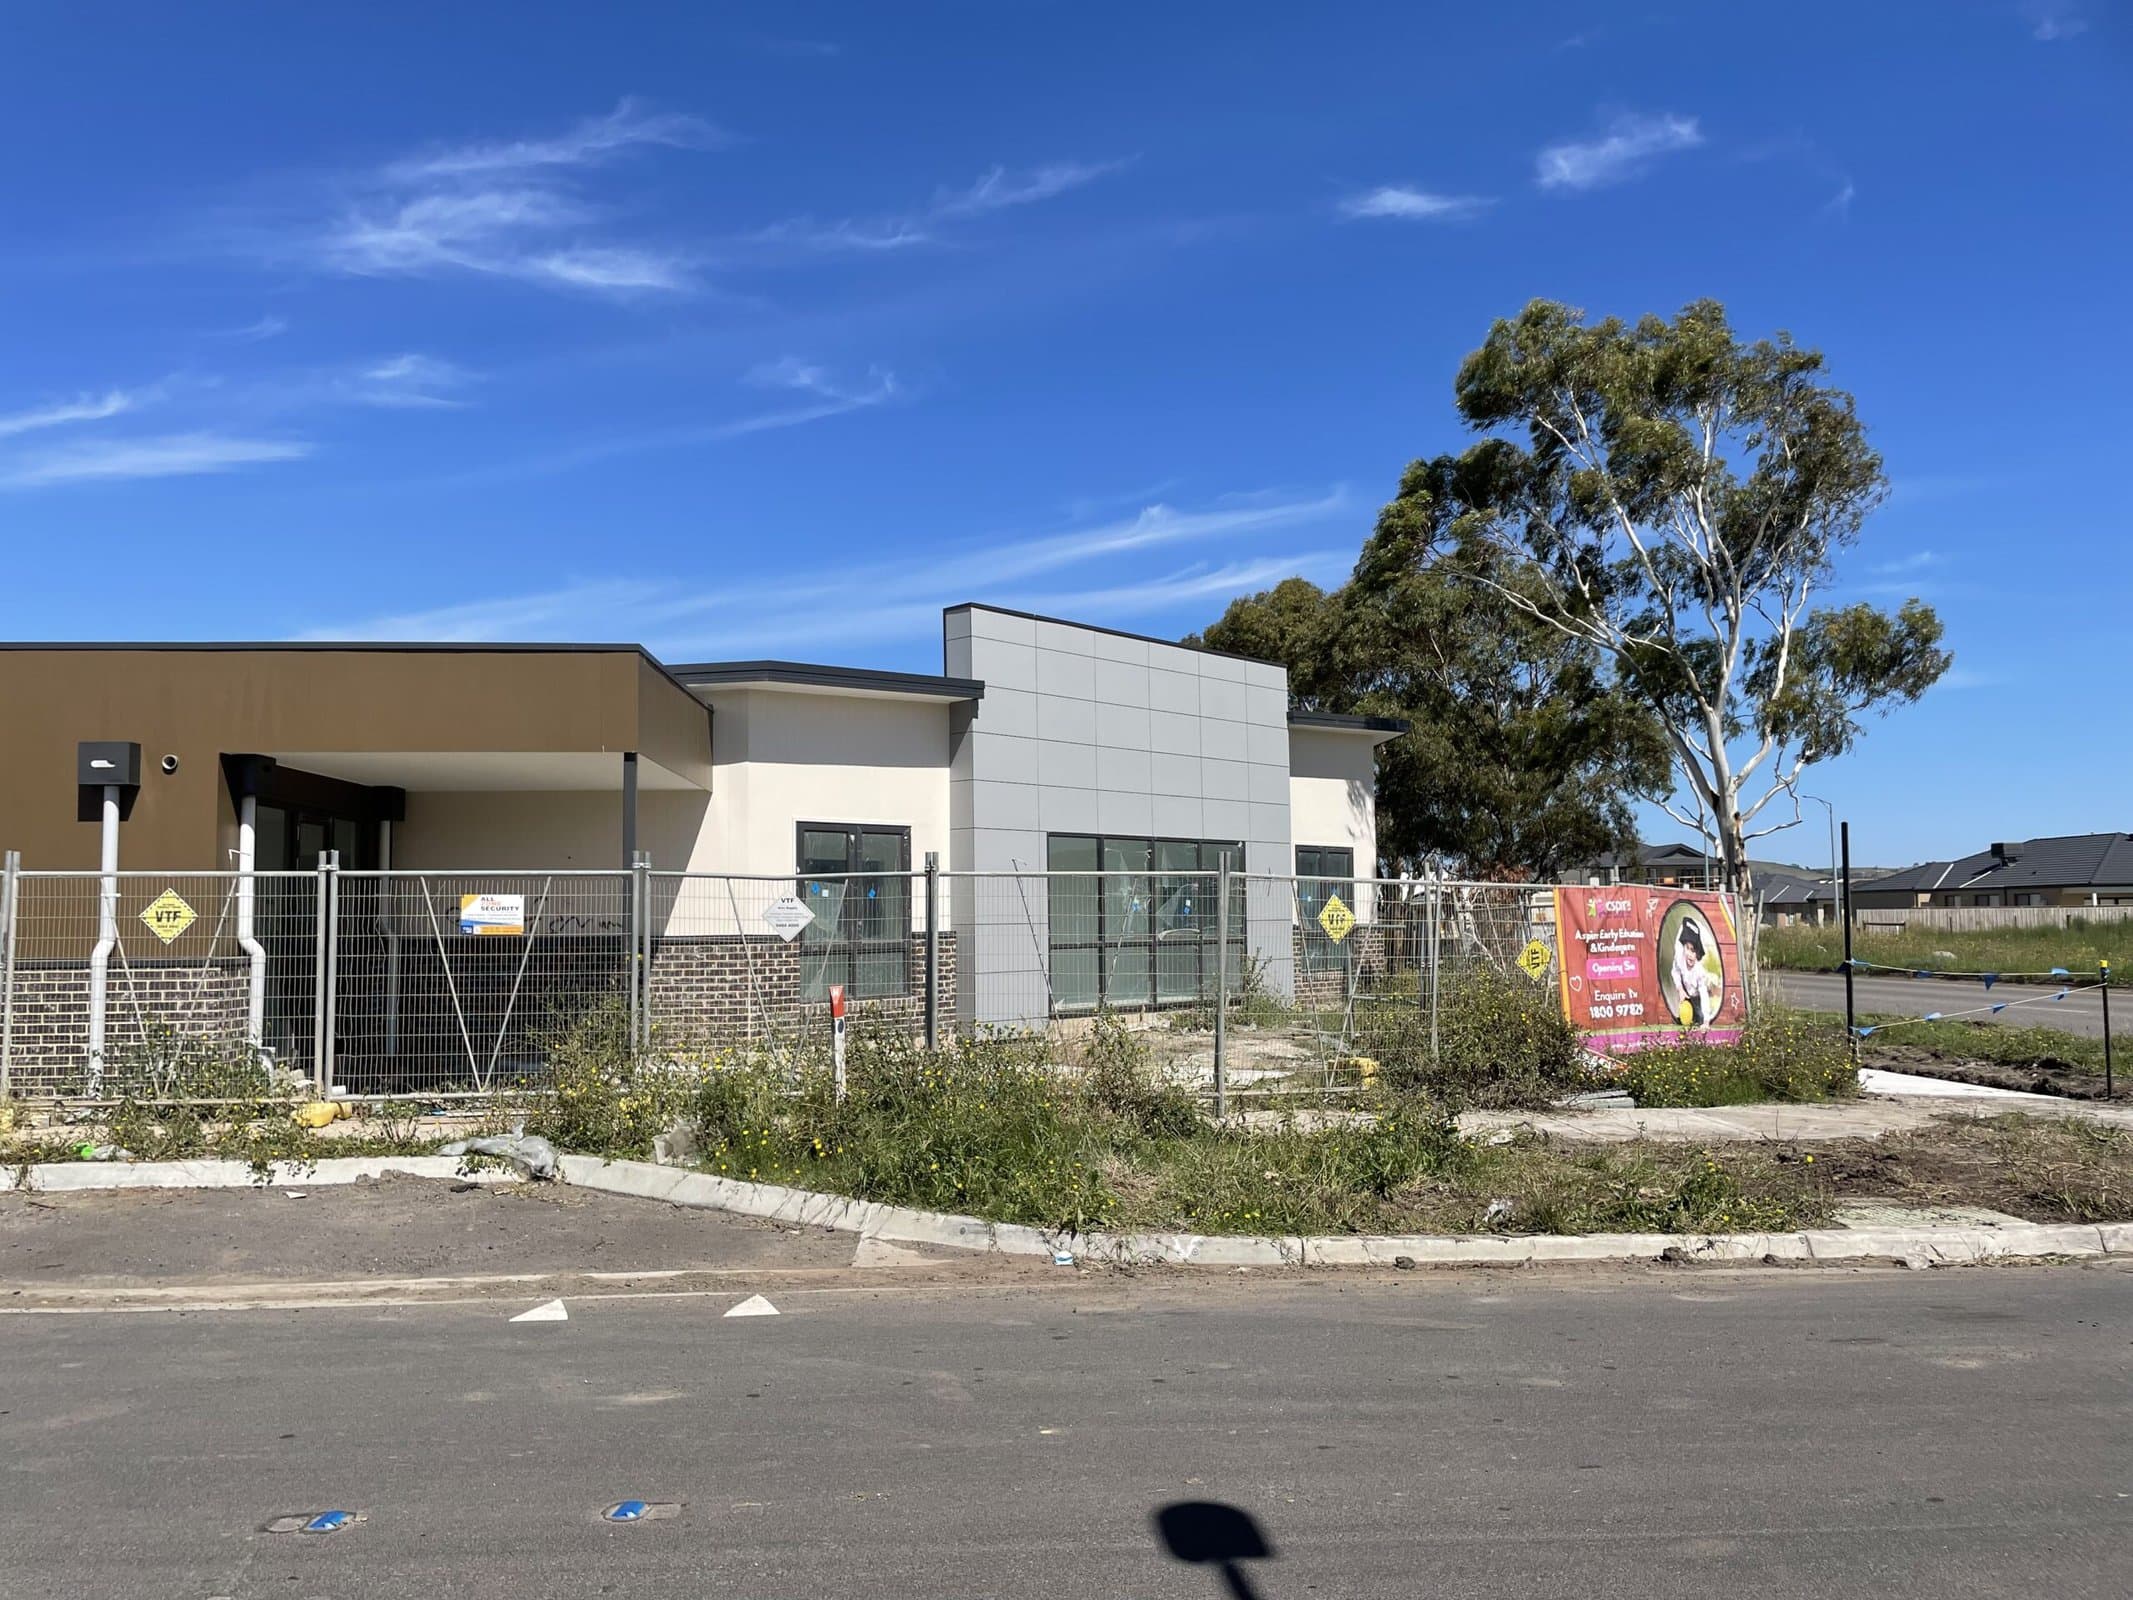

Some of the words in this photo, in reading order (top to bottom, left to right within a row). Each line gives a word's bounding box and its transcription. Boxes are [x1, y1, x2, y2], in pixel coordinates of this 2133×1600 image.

[155, 910, 181, 922] VTF
[1600, 927, 1619, 943] Early
[1590, 942, 1598, 953] &
[1530, 948, 1540, 969] VTF
[1592, 961, 1624, 976] Opening
[1594, 988, 1626, 1004] Enquire
[1589, 1003, 1613, 1018] 1800
